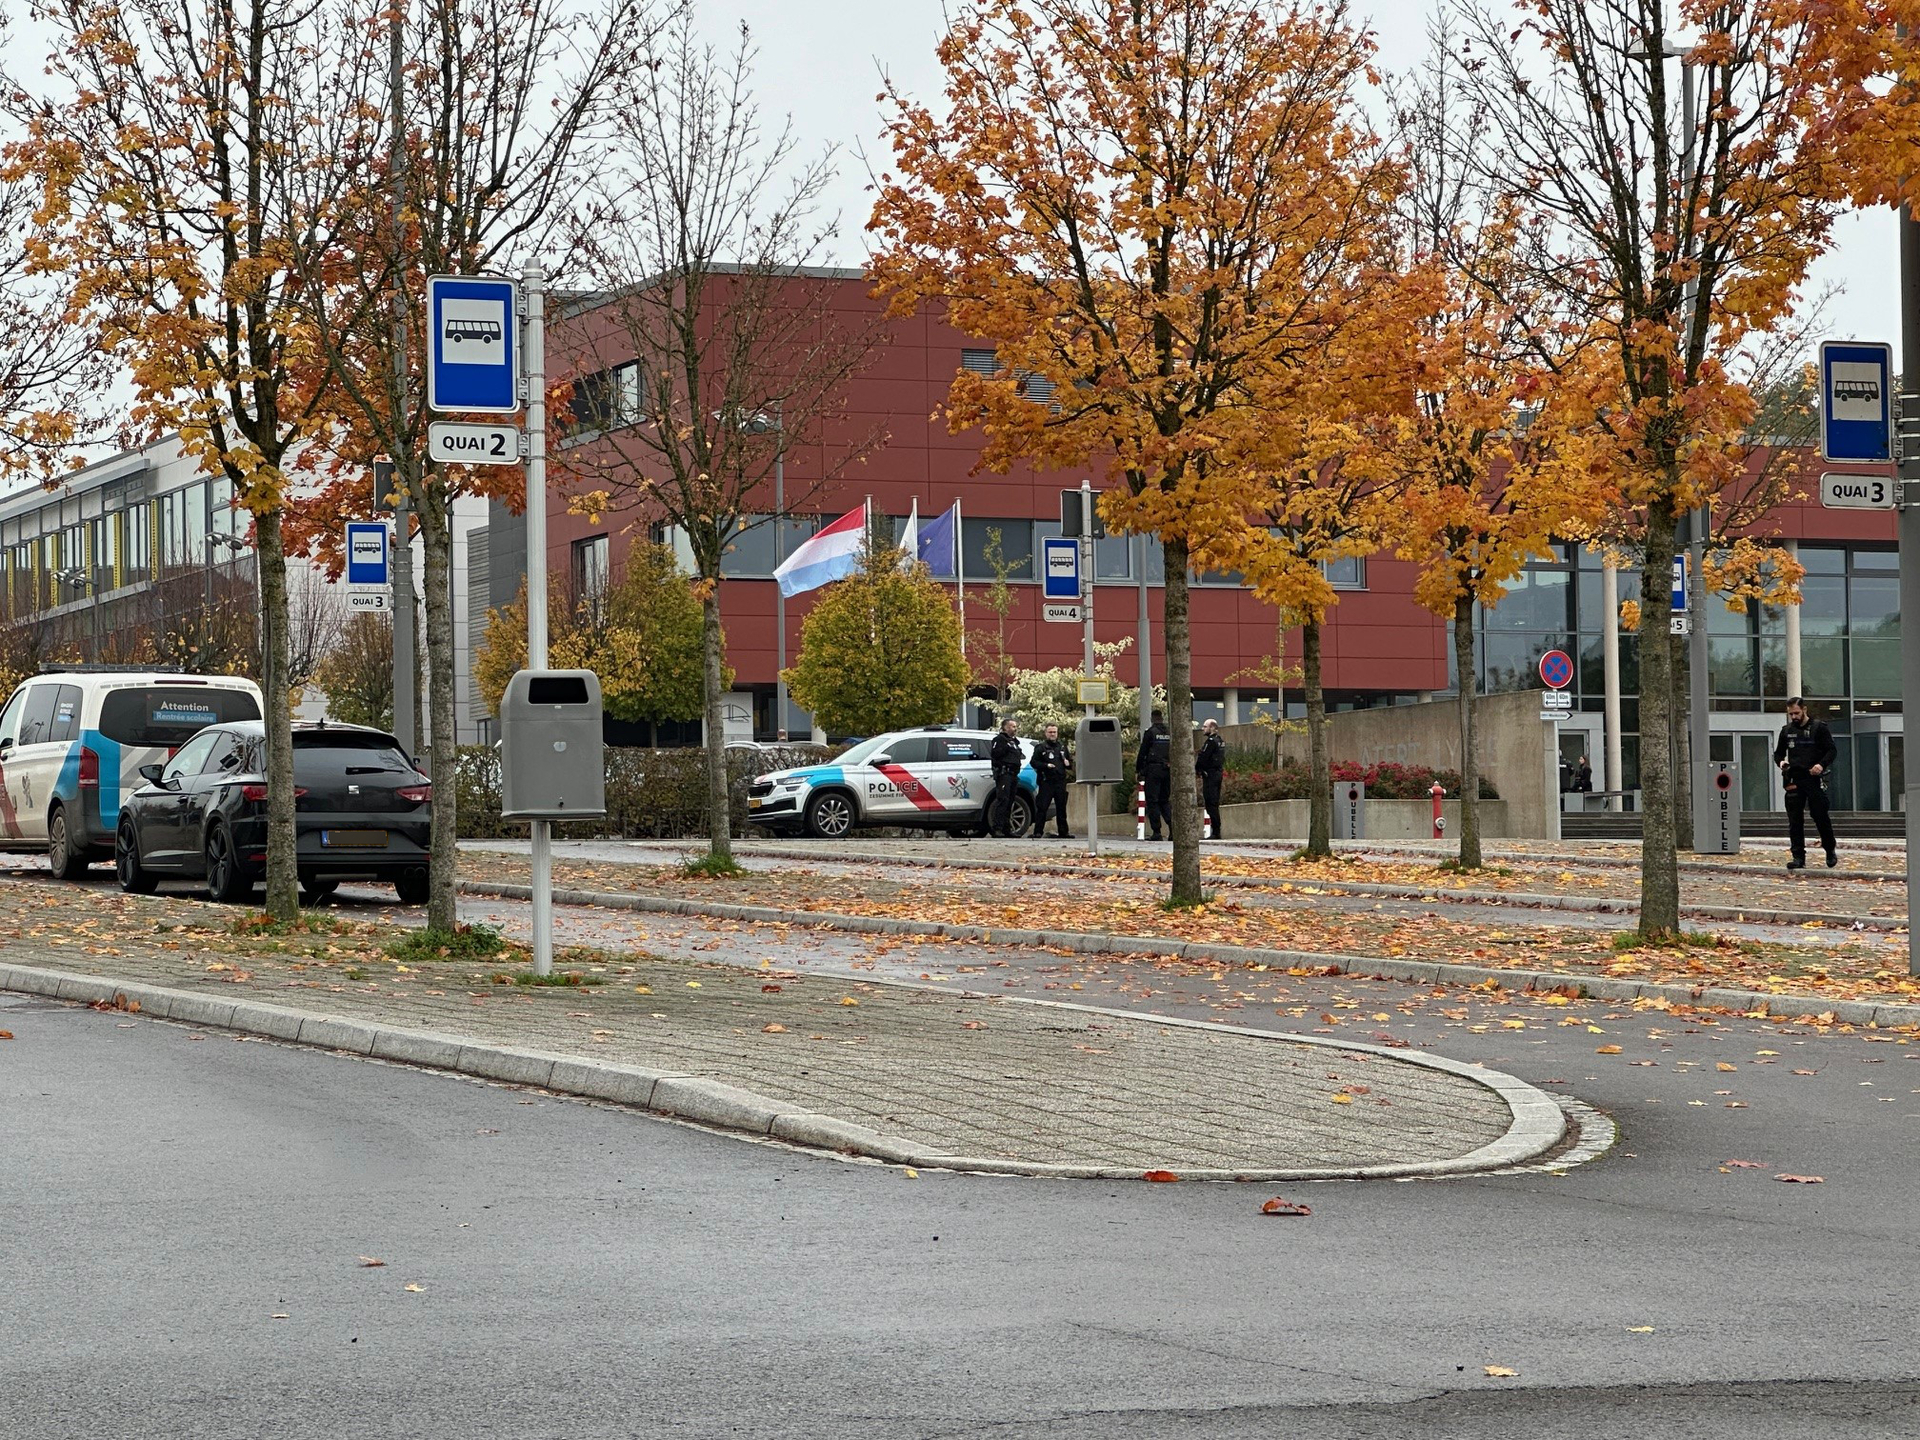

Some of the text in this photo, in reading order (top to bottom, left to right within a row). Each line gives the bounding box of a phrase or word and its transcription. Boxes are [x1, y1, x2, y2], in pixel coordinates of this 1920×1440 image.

[442, 433, 506, 456] QUAI 2
[1832, 482, 1884, 503] QUAI 3
[352, 596, 384, 608] QUAI 3
[1068, 608, 1077, 618] 4
[1676, 620, 1683, 630] 5
[160, 700, 209, 712] Attention
[156, 712, 214, 722] Rentrée scolaire
[868, 781, 918, 793] POLICE
